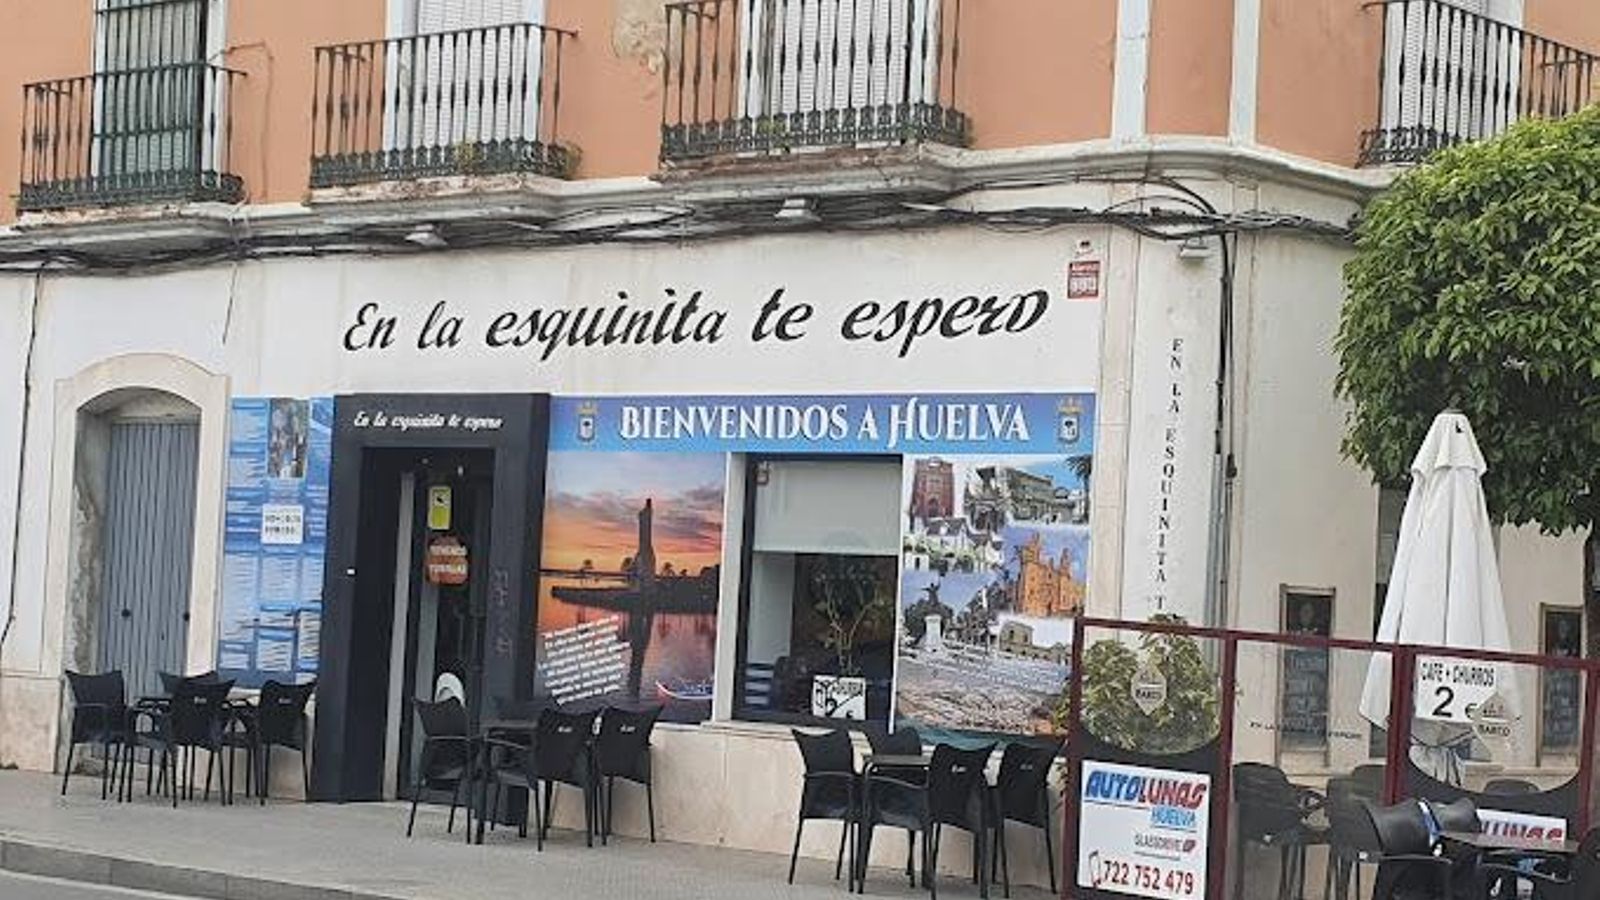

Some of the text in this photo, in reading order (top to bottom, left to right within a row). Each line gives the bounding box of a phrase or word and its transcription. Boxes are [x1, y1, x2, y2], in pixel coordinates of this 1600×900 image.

[343, 288, 1050, 362] En la esquinita te espero
[353, 411, 370, 427] En
[373, 411, 387, 427] la
[391, 413, 446, 431] esquinita
[619, 397, 1030, 449] BIENVENIDOS A HUELVA
[1432, 686, 1454, 718] 2
[1086, 770, 1207, 810] AUTOLUNAS
[1104, 860, 1194, 895] 722 752 479
